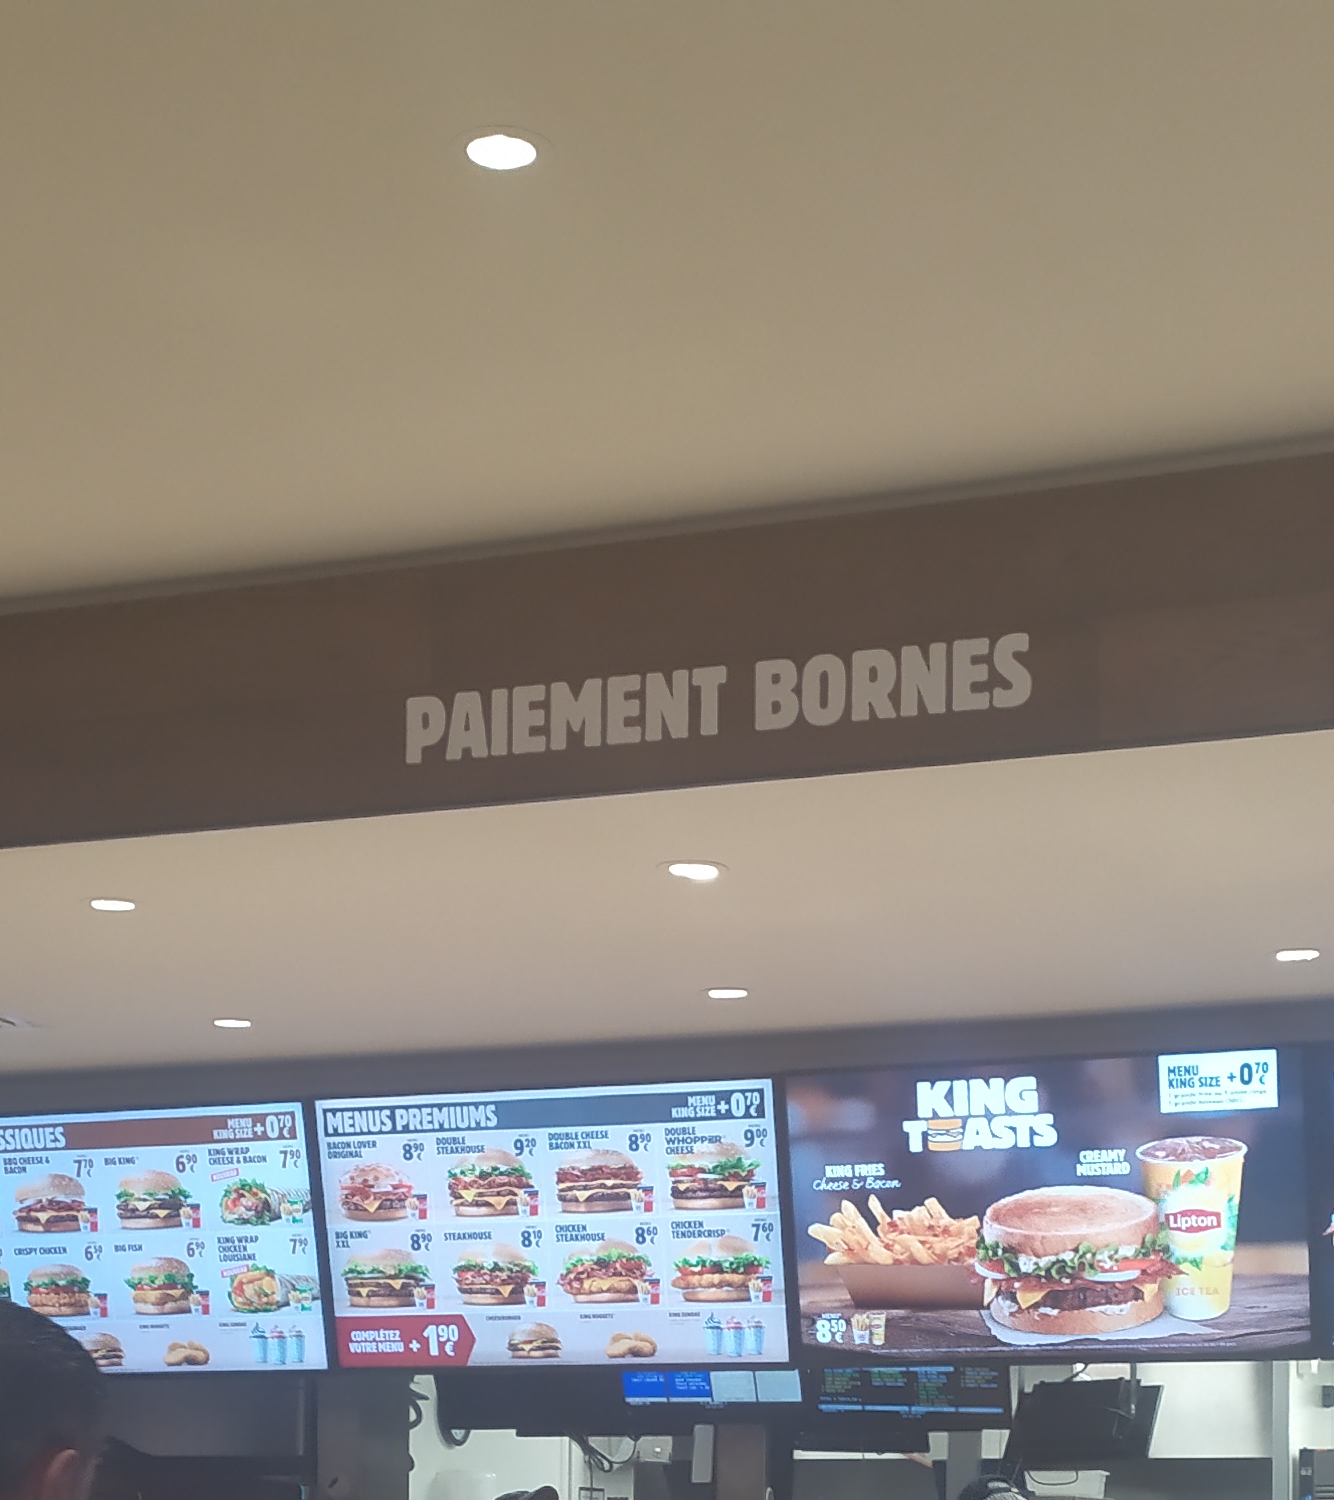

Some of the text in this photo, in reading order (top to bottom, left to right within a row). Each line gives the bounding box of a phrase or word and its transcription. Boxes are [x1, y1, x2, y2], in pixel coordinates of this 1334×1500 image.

[406, 633, 1032, 763] PAIEMENT BORNES
[1168, 1065, 1198, 1077] MENU
[1168, 1076, 1221, 1089] KING SIZE
[688, 1095, 715, 1106] MENU
[916, 1076, 1038, 1118] KING
[671, 1105, 716, 1118] KING SIZE
[227, 1118, 252, 1130] MENU
[326, 1105, 497, 1134] MENUS PREMIUMS
[213, 1128, 253, 1140] KING SIZE
[548, 1130, 609, 1140] DOUBLE CHEESE
[665, 1127, 696, 1136] DOUBLE
[327, 1140, 377, 1150] BACON LOVER
[436, 1136, 466, 1145] DOUBLE
[549, 1140, 592, 1149] BACON XXL
[665, 1135, 722, 1145] WHOPPER
[208, 1146, 250, 1157] KING WRAP
[327, 1150, 363, 1160] ORIGINAL
[436, 1145, 485, 1155] STEAKHOUSE
[666, 1145, 694, 1155] CHEESE
[104, 1157, 136, 1165] BIG KING
[208, 1155, 267, 1165] CHEESE & BACON
[1079, 1150, 1126, 1164] CREAMY
[825, 1164, 884, 1177] KING FRIES
[1076, 1162, 1130, 1176] MUSTARD
[671, 1221, 704, 1229] CHICKEN
[1169, 1213, 1218, 1230] Lipton
[555, 1224, 587, 1233] CHICKEN
[671, 1228, 726, 1239] TENDERCRISP
[237, 1235, 259, 1243] WRAP
[335, 1230, 368, 1240] BIG KING
[444, 1231, 492, 1241] STEAKHOUSE
[556, 1232, 606, 1242] STEAKHOUSE
[128, 1244, 143, 1252] FISH
[218, 1245, 248, 1253] CHICKEN
[336, 1240, 351, 1248] XXL
[219, 1253, 256, 1262] LOUISIANE
[351, 1329, 400, 1342] COMPLÉTEZ
[349, 1341, 404, 1353] VOTRE MENU
